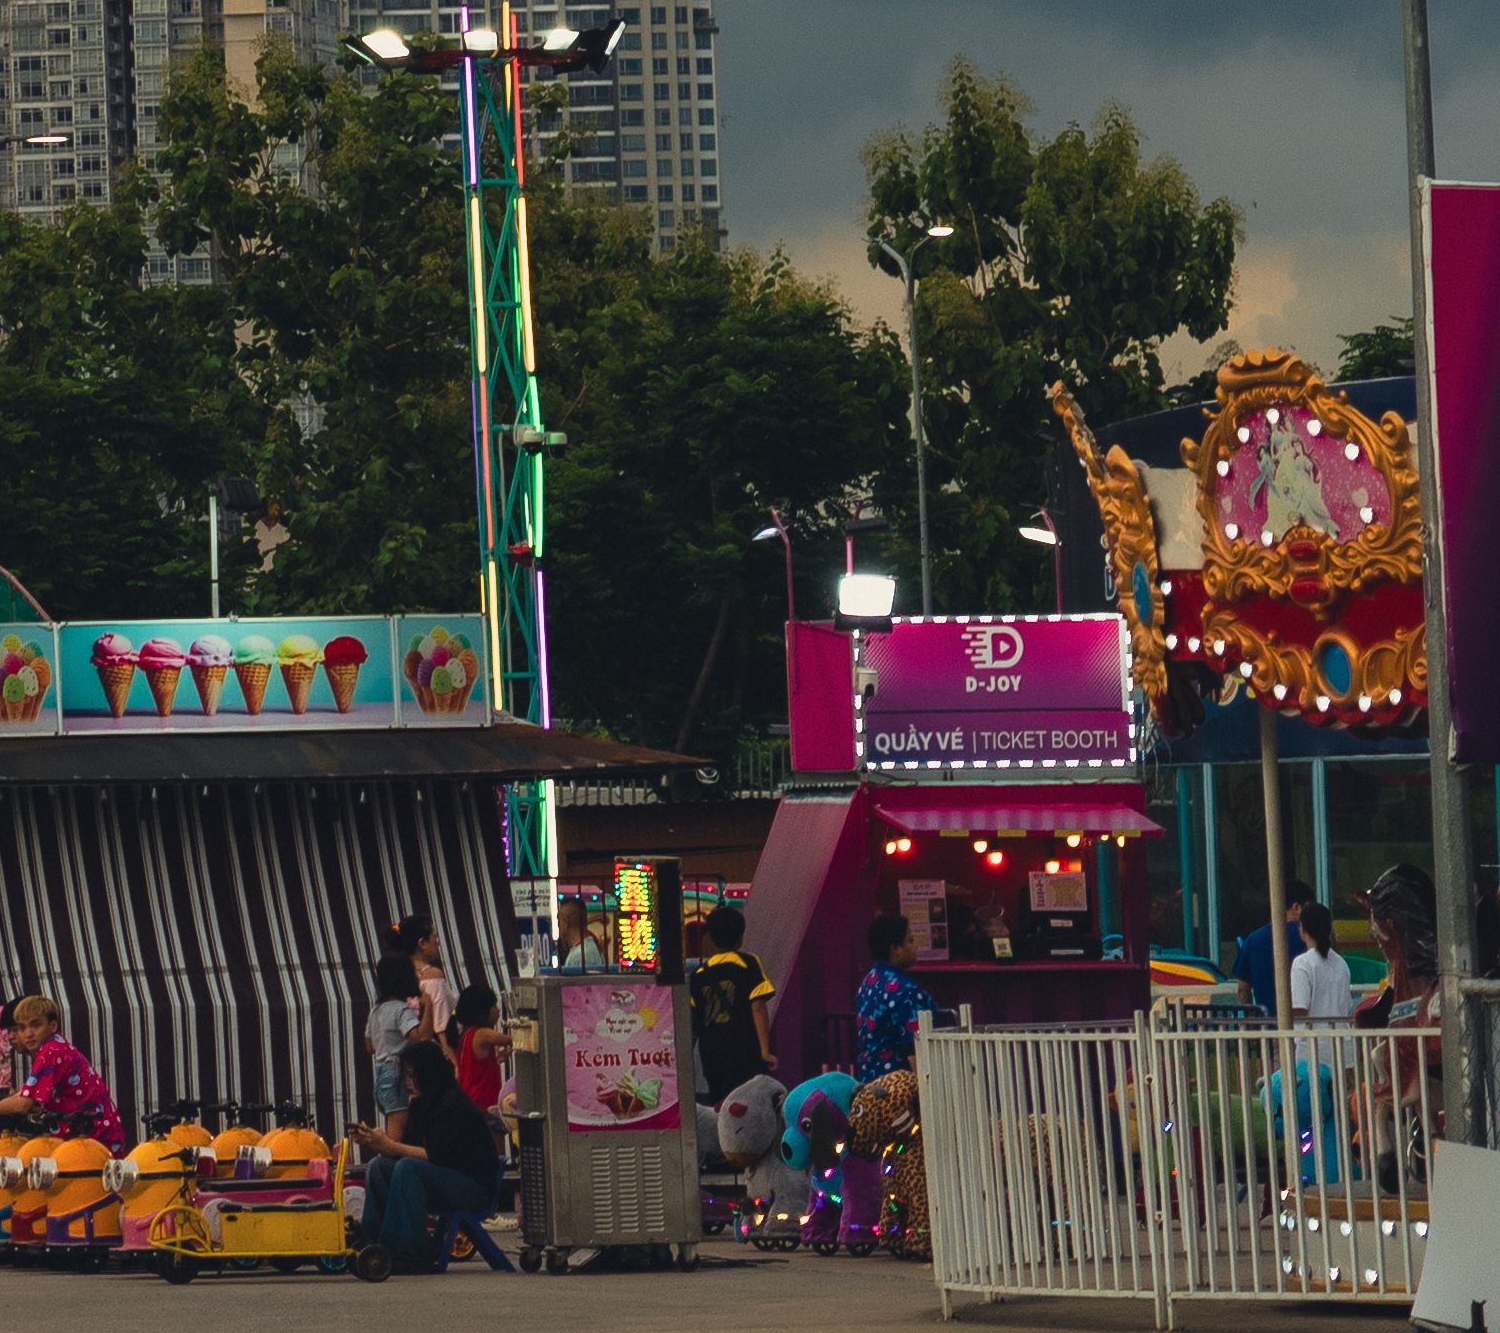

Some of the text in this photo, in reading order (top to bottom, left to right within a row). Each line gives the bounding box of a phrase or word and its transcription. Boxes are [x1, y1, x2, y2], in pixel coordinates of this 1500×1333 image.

[965, 675, 1022, 693] D-JOY
[874, 724, 932, 752] QUẦY
[937, 726, 964, 751] VÉ
[980, 730, 1047, 750] TICKET
[1051, 729, 1119, 749] BOOTH
[575, 1049, 621, 1068] Kem
